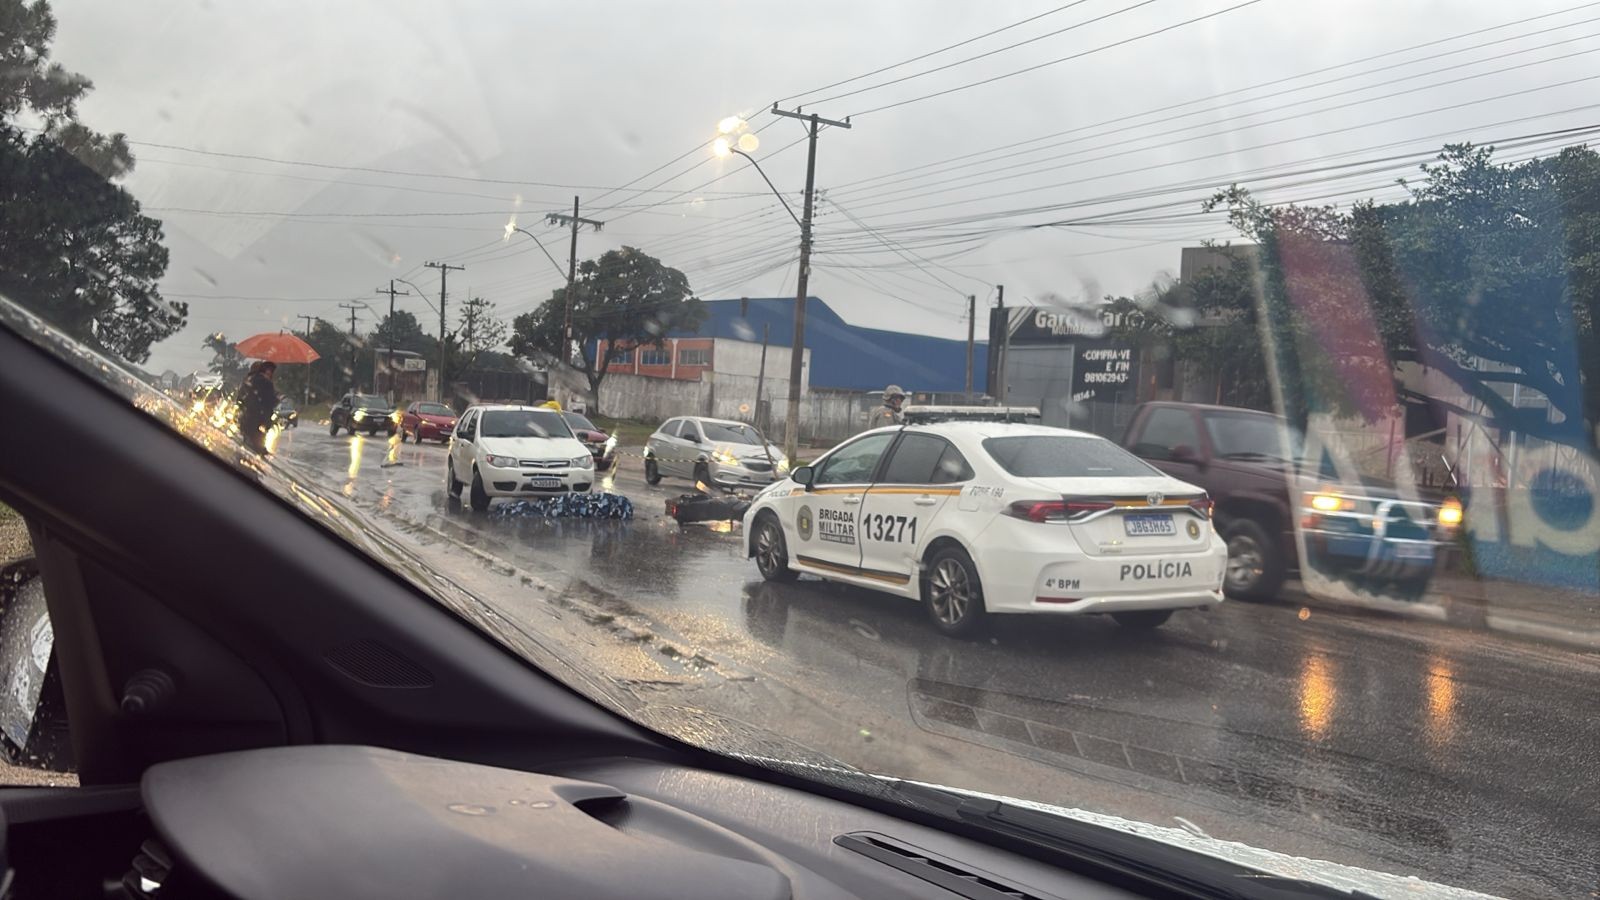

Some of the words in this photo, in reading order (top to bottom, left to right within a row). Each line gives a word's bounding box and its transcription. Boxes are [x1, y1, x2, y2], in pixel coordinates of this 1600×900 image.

[819, 508, 854, 523] BRIGADA
[819, 521, 855, 536] MILITAR
[863, 513, 917, 544] 13271
[1120, 560, 1192, 581] POLÍCIA
[1058, 579, 1080, 590] BPM
